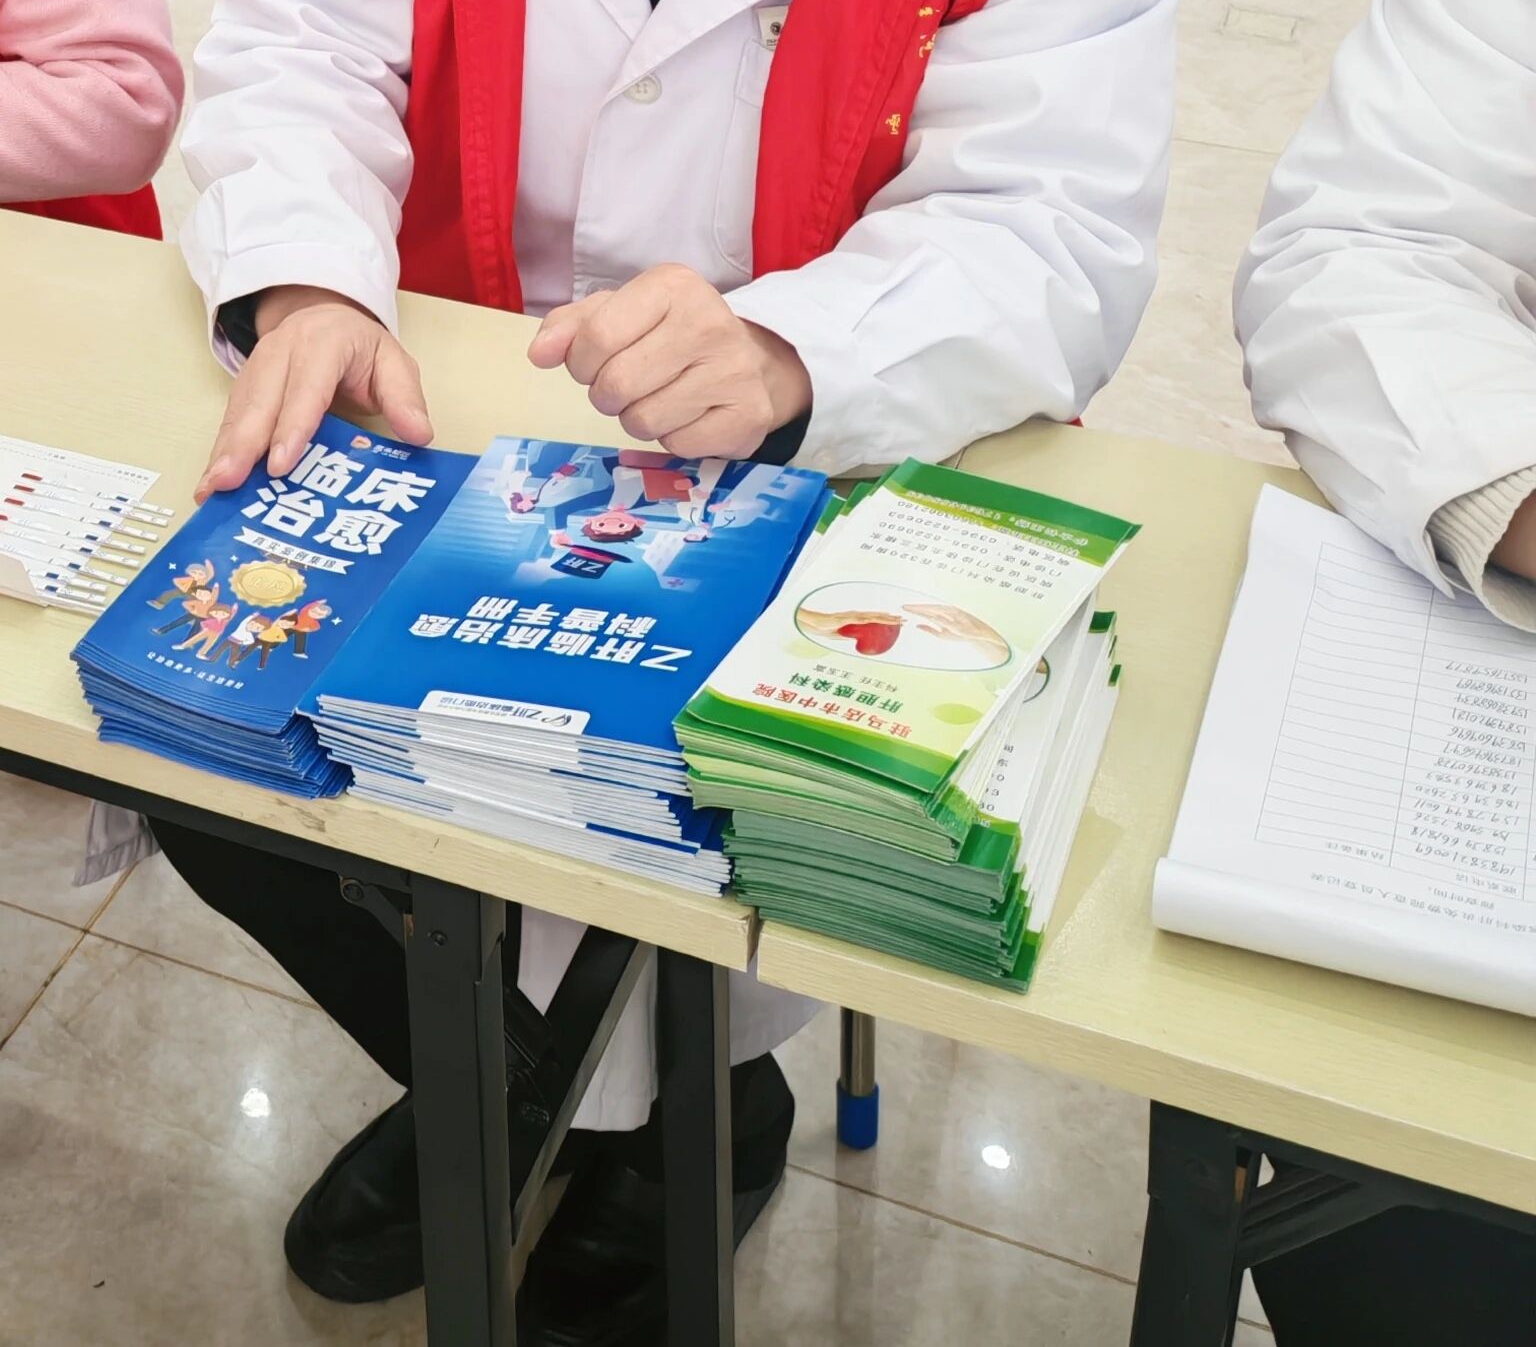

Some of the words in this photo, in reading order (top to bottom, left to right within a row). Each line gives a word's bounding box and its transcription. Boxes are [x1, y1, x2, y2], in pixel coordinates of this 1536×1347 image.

[288, 442, 439, 513] 临床
[240, 478, 405, 557] 治愈
[560, 555, 603, 576] 乙肝
[407, 612, 694, 673] 乙肝临床治愈
[464, 595, 659, 639] 科普手册
[752, 683, 913, 739] 驻马店市中医院
[788, 672, 904, 714] 肝胆感染科
